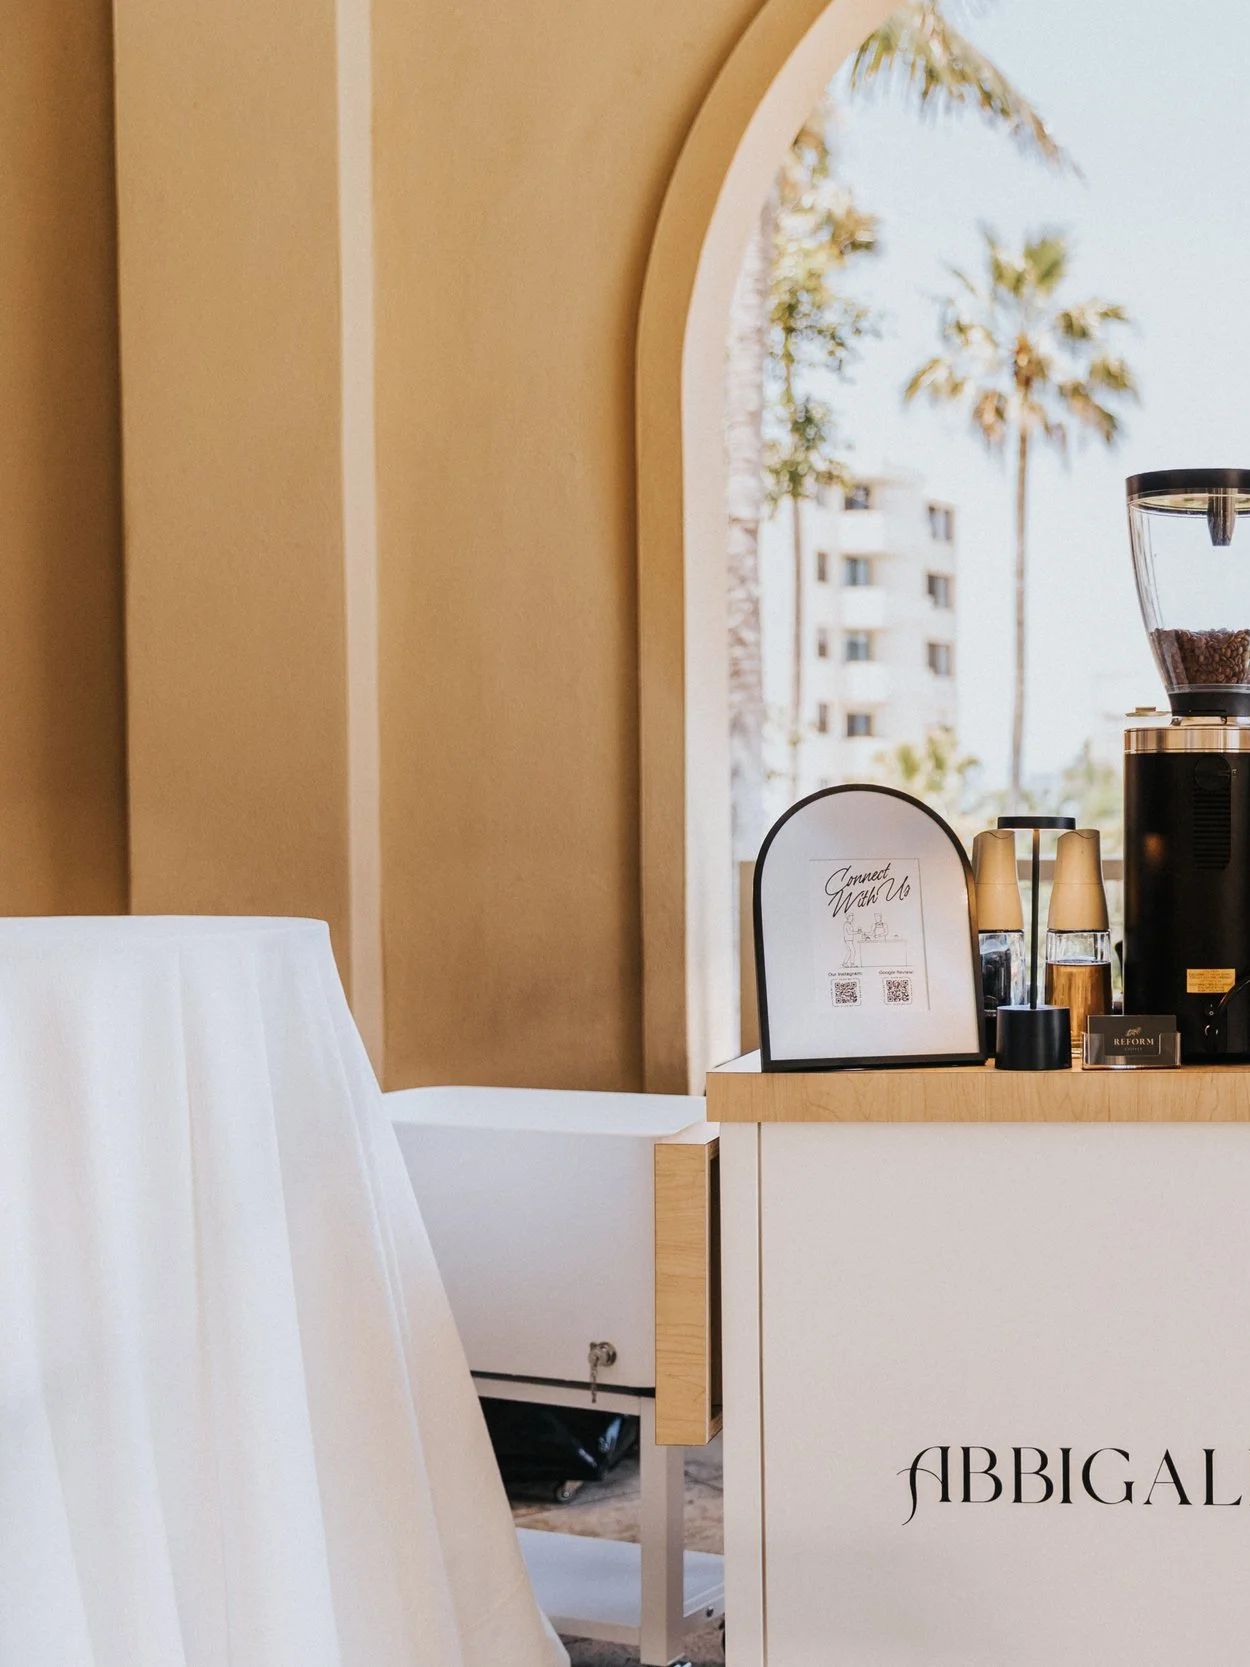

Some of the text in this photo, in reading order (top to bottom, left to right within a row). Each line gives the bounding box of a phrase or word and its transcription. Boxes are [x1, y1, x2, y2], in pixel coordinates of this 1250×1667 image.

[825, 863, 891, 896] Connect
[828, 876, 911, 918] With Us
[1113, 1038, 1154, 1046] REFORM
